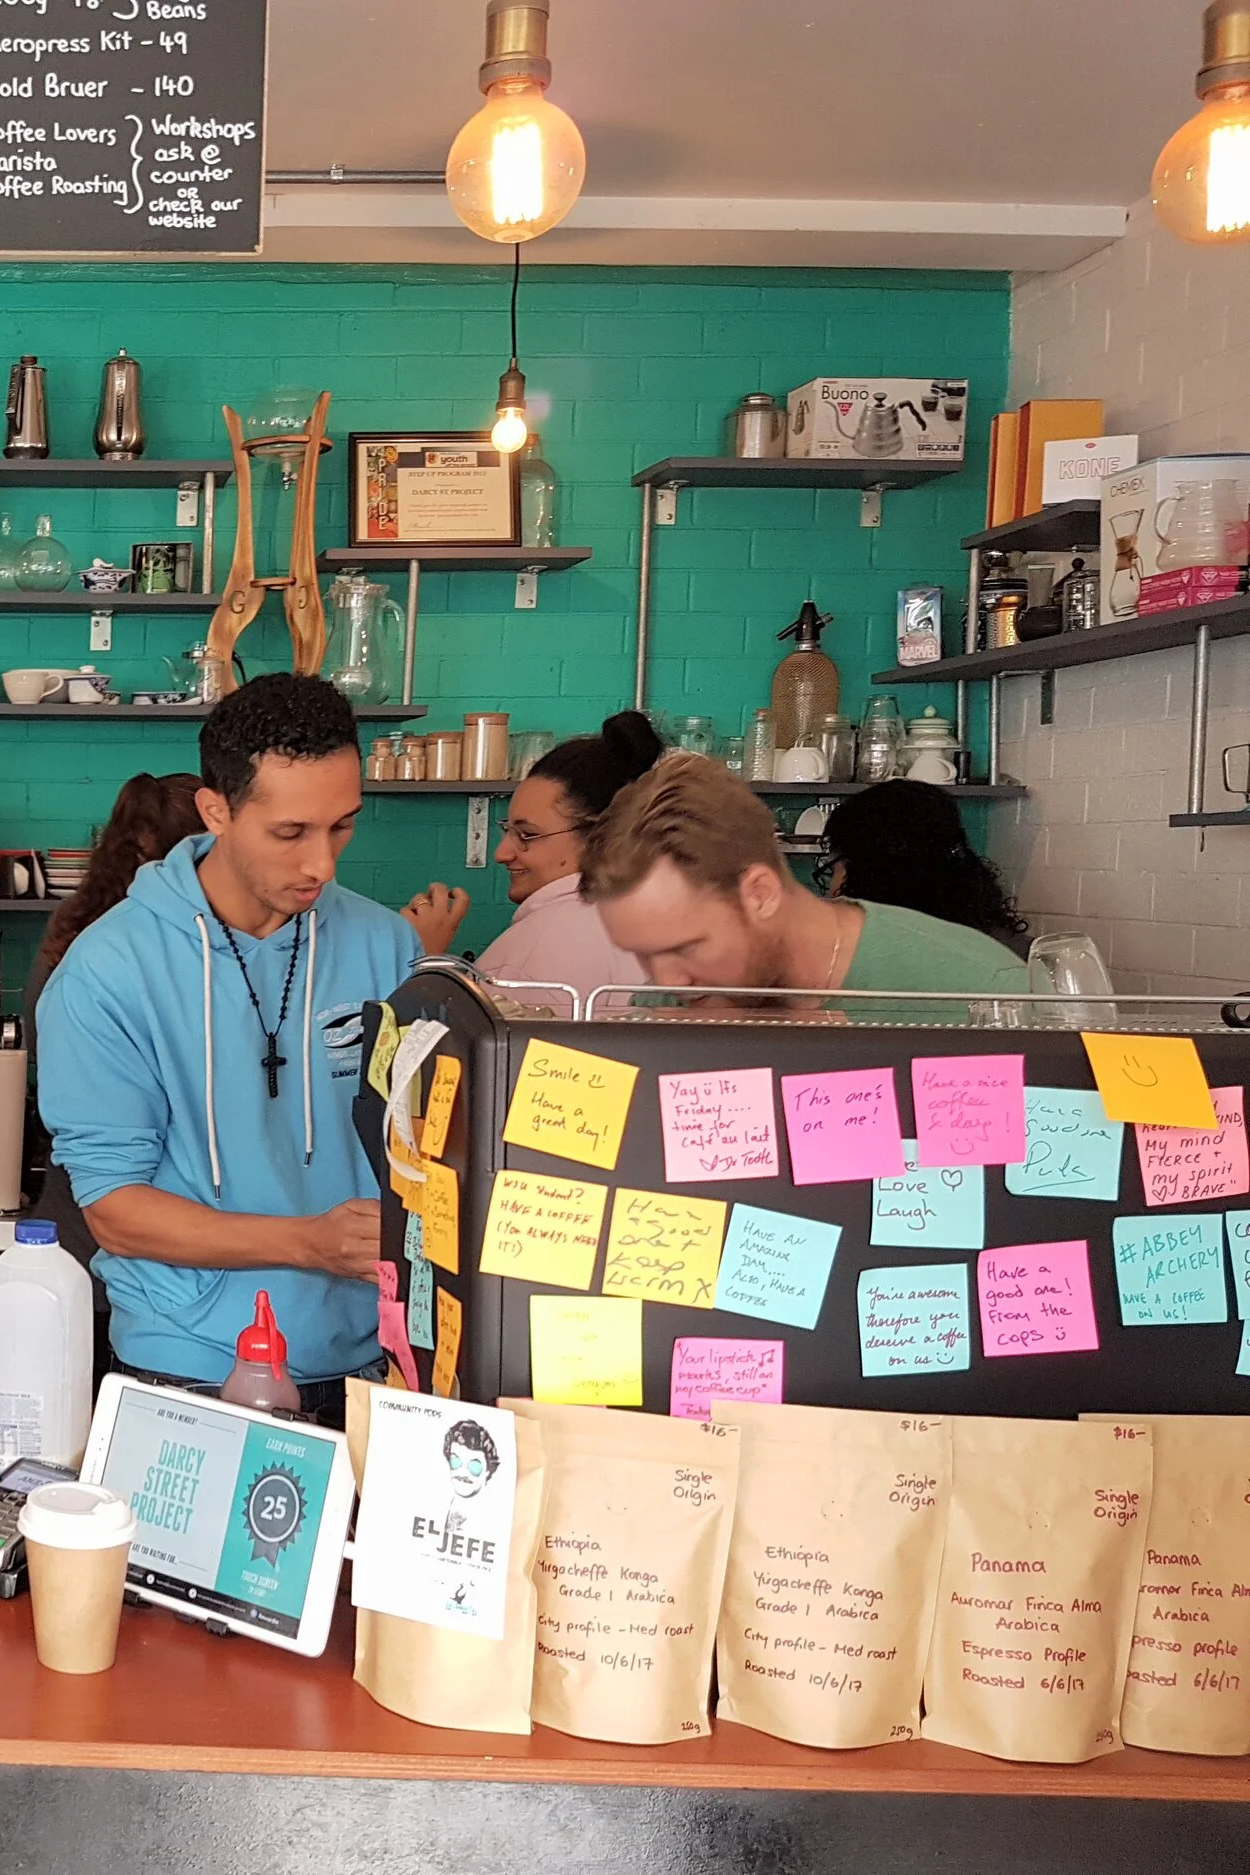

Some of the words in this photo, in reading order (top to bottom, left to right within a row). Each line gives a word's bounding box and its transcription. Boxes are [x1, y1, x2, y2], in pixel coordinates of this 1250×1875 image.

[147, 2, 207, 20] Beans
[101, 30, 133, 50] Kit
[159, 31, 187, 54] 49
[45, 73, 108, 97] Bruer
[154, 75, 194, 97] 140
[54, 122, 116, 146] Lovers
[151, 114, 256, 145] Workshops
[154, 141, 195, 161] ask
[150, 167, 233, 184] counter
[52, 174, 128, 206] Roasting
[149, 198, 203, 213] check
[211, 198, 243, 211] our
[148, 213, 217, 228] website
[822, 385, 869, 400] Buono
[1059, 457, 1121, 479] KONE
[1110, 478, 1145, 497] CHEMEX
[528, 1059, 580, 1082] Smile
[531, 1091, 564, 1112] Have
[670, 1081, 699, 1105] Yay
[796, 1087, 830, 1111] This
[532, 1115, 566, 1131] great
[803, 1121, 823, 1132] on
[1180, 1132, 1224, 1147] mind
[1189, 1163, 1233, 1184] spirit
[877, 1177, 928, 1194] Love
[876, 1199, 937, 1230] Laugh
[987, 1261, 1028, 1281] Have
[1145, 1246, 1220, 1287] ARCHERY
[908, 1289, 960, 1300] awesome
[986, 1284, 1023, 1306] good
[1040, 1302, 1073, 1317] the
[866, 1313, 921, 1334] therefore
[930, 1311, 959, 1329] you
[865, 1334, 915, 1349] deserve
[937, 1327, 967, 1348] coffee
[889, 1357, 907, 1366] on
[914, 1355, 932, 1365] us
[158, 1439, 206, 1476] DARCY
[144, 1466, 200, 1505] STREET
[675, 1469, 713, 1485] Single
[894, 1472, 937, 1492] Single
[674, 1486, 716, 1505] Origin
[889, 1491, 935, 1512] Origin
[1094, 1489, 1139, 1506] Single
[130, 1492, 194, 1534] PROJECT
[261, 1496, 288, 1520] 25
[1093, 1507, 1138, 1527] Origin
[412, 1516, 440, 1538] EL
[436, 1531, 496, 1564] JEFE
[545, 1531, 602, 1555] Ethiopia
[764, 1545, 830, 1568] Ethiopia
[971, 1552, 1047, 1573] Panama
[1147, 1549, 1201, 1566] Panama
[621, 1566, 658, 1587] Konga
[559, 1584, 601, 1601] Grade
[626, 1589, 675, 1605] Arabica
[843, 1582, 883, 1608] Konga
[1191, 1581, 1222, 1598] Finca
[755, 1597, 797, 1615] Grade
[825, 1603, 879, 1621] Arabica
[951, 1591, 1013, 1612] Auromar
[1026, 1595, 1063, 1613] Finca
[1071, 1598, 1102, 1613] Alma
[1152, 1606, 1209, 1622] Arabica
[567, 1616, 611, 1637] profile
[664, 1624, 694, 1636] roast
[996, 1617, 1060, 1633] Arabica
[744, 1628, 768, 1650] City
[774, 1633, 816, 1652] profile
[867, 1647, 898, 1661] roast
[962, 1640, 1032, 1662] Espresso
[1194, 1639, 1238, 1659] profile
[601, 1651, 654, 1671] 10/6/17
[745, 1660, 796, 1681] Roasted
[809, 1672, 862, 1695] 10/6/17
[962, 1668, 1024, 1690] Roasted
[1040, 1674, 1084, 1694] 6/6/17
[1194, 1668, 1240, 1692] 6/6/17
